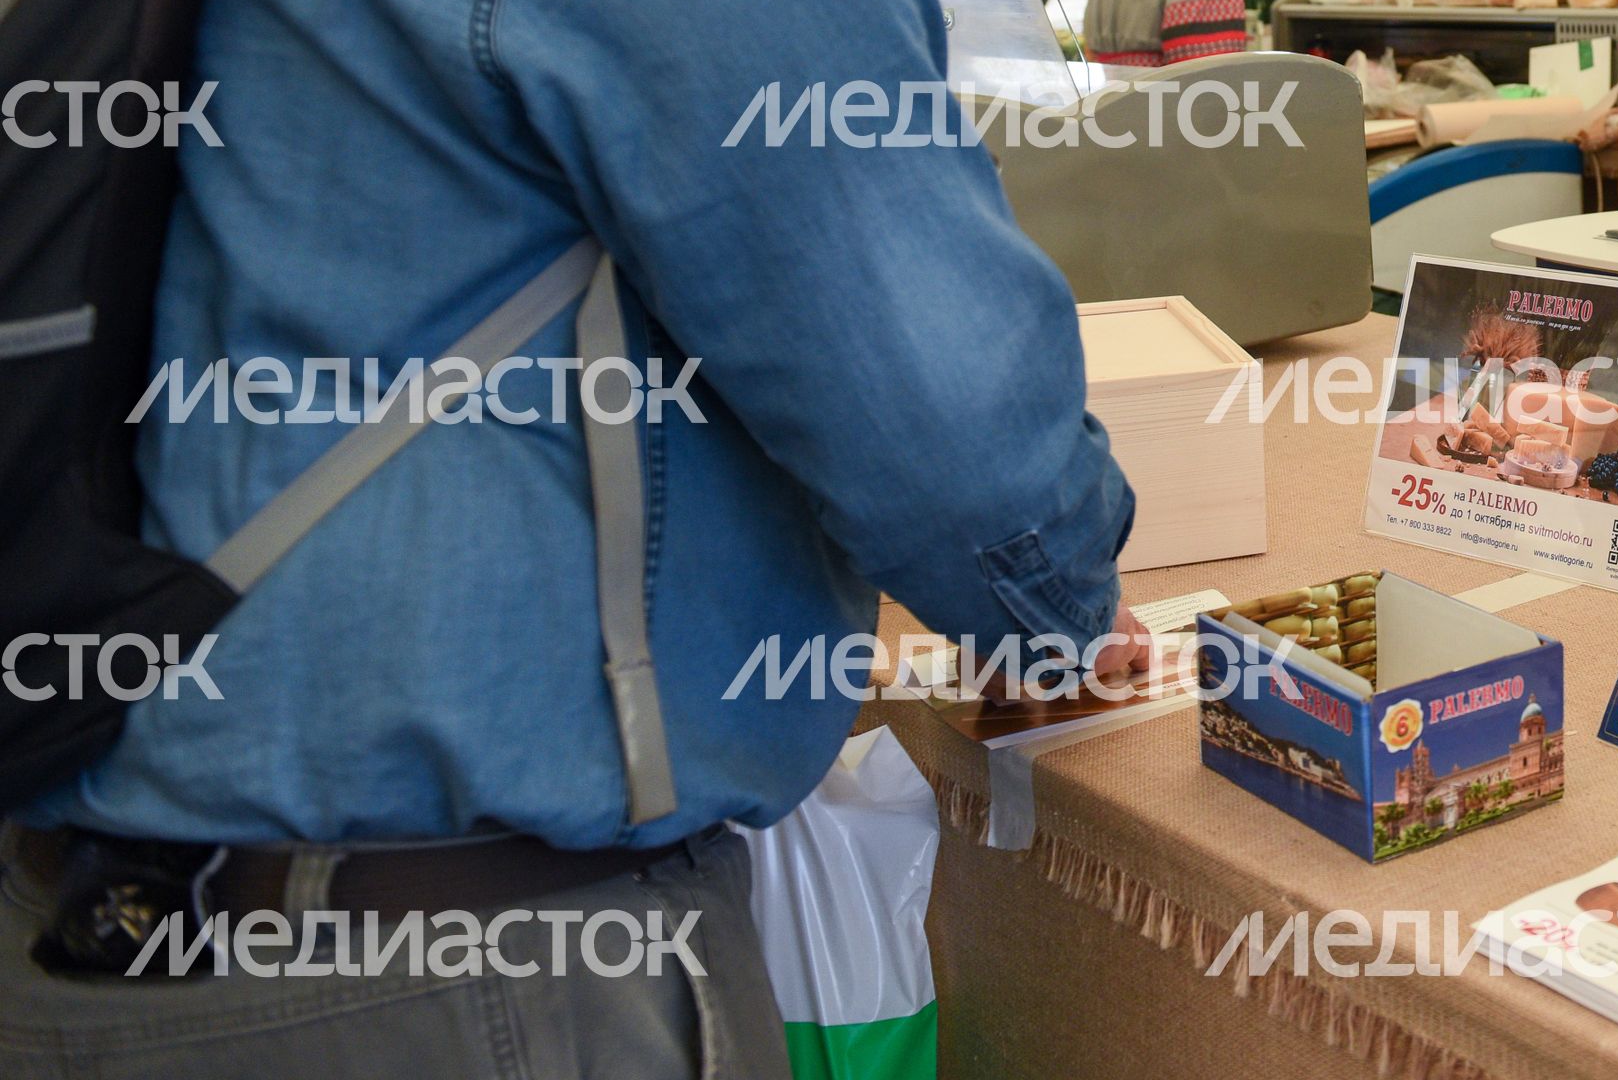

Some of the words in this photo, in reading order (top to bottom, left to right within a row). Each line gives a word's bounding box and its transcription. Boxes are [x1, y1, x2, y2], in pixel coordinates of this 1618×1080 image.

[1506, 290, 1594, 322] PALERMO
[1391, 474, 1447, 515] -25%
[1454, 491, 1466, 501] на
[1468, 488, 1538, 517] PALERMO
[1409, 520, 1421, 530] 800
[1422, 523, 1435, 533] 333
[1436, 526, 1452, 536] 8822
[1450, 508, 1463, 519] до
[1467, 509, 1471, 520] 1
[1474, 513, 1512, 530] октября
[1514, 522, 1526, 532] на
[1528, 524, 1593, 547] svitmoloko.ru
[1269, 664, 1353, 737] PALERMO
[1396, 715, 1409, 737] 6
[1429, 675, 1525, 725] PALERMO
